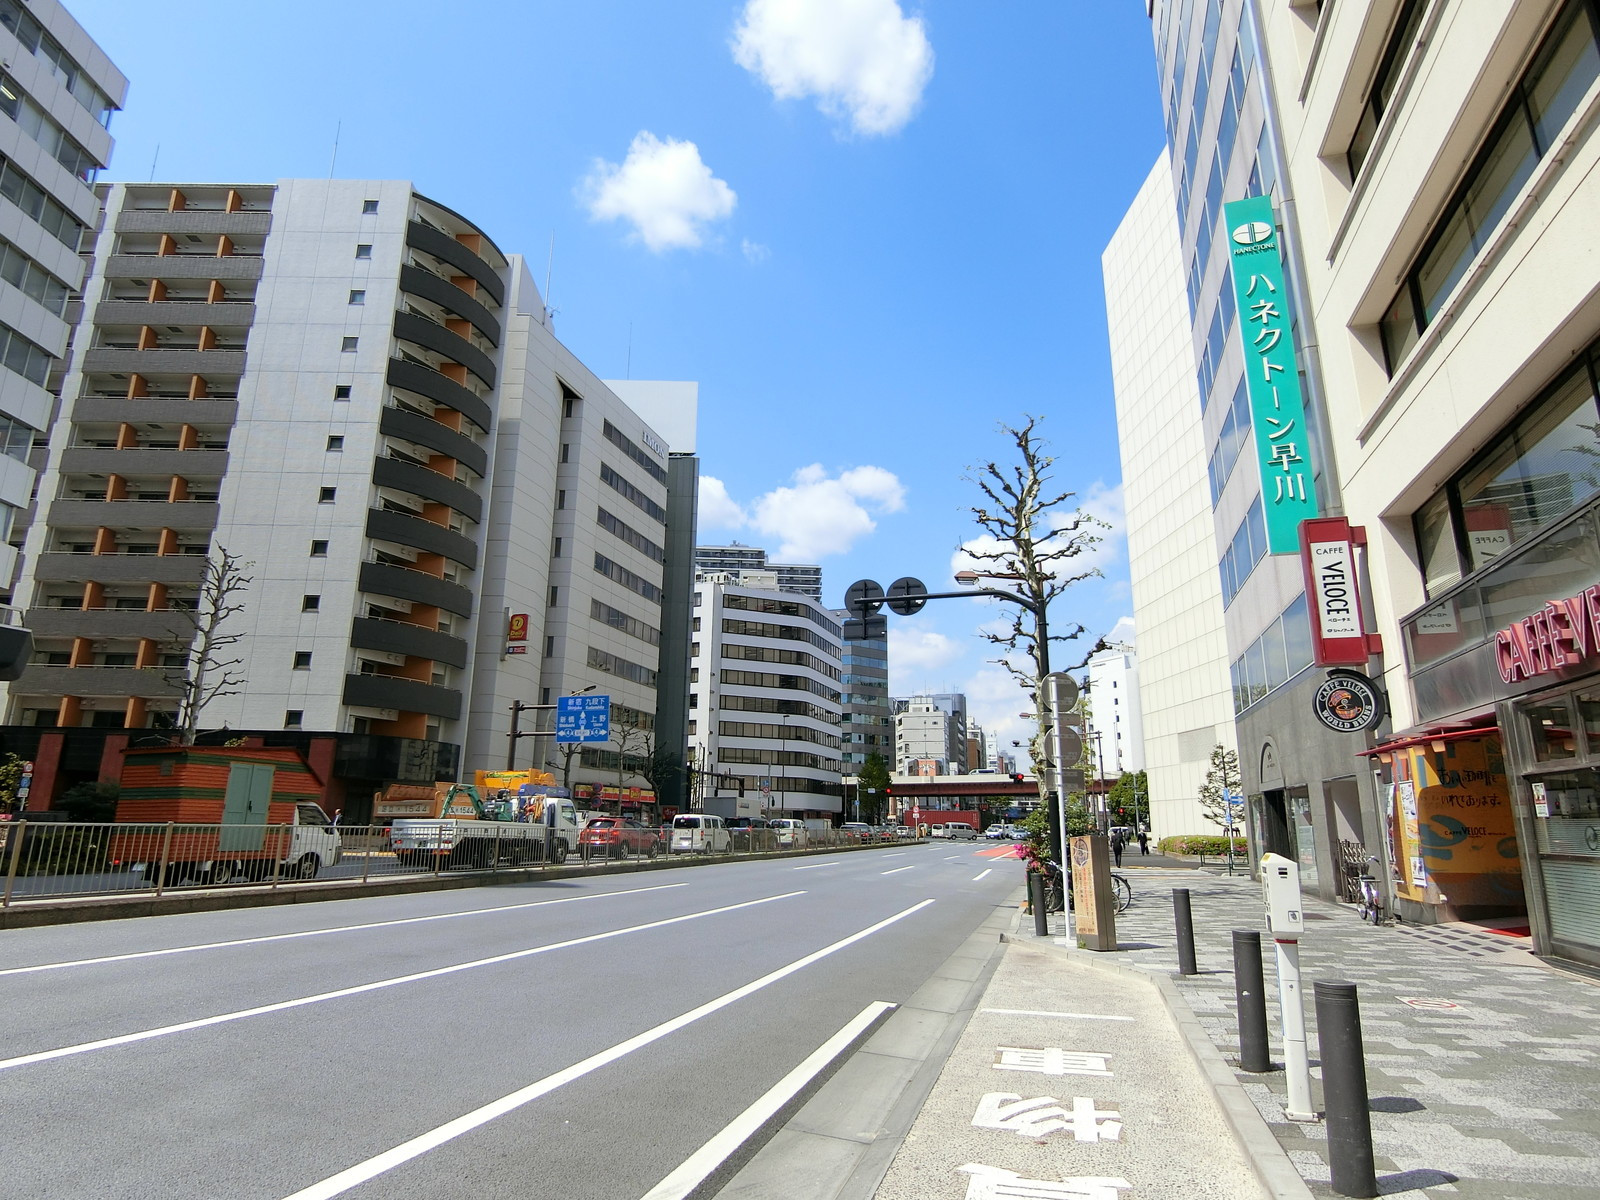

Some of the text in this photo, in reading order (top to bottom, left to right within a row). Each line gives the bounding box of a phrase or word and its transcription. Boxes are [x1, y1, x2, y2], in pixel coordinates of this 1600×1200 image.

[1233, 243, 1276, 255] HANECTONE
[1246, 272, 1307, 503] ハネクトーン早川
[1315, 546, 1344, 555] CAFFE
[1321, 560, 1350, 616] VELOCE
[1494, 602, 1568, 684] CAFFE
[1319, 680, 1368, 702] CAFFE VELOCE
[1321, 704, 1372, 729] WORLD BEANS
[1461, 826, 1488, 837] VELOCE
